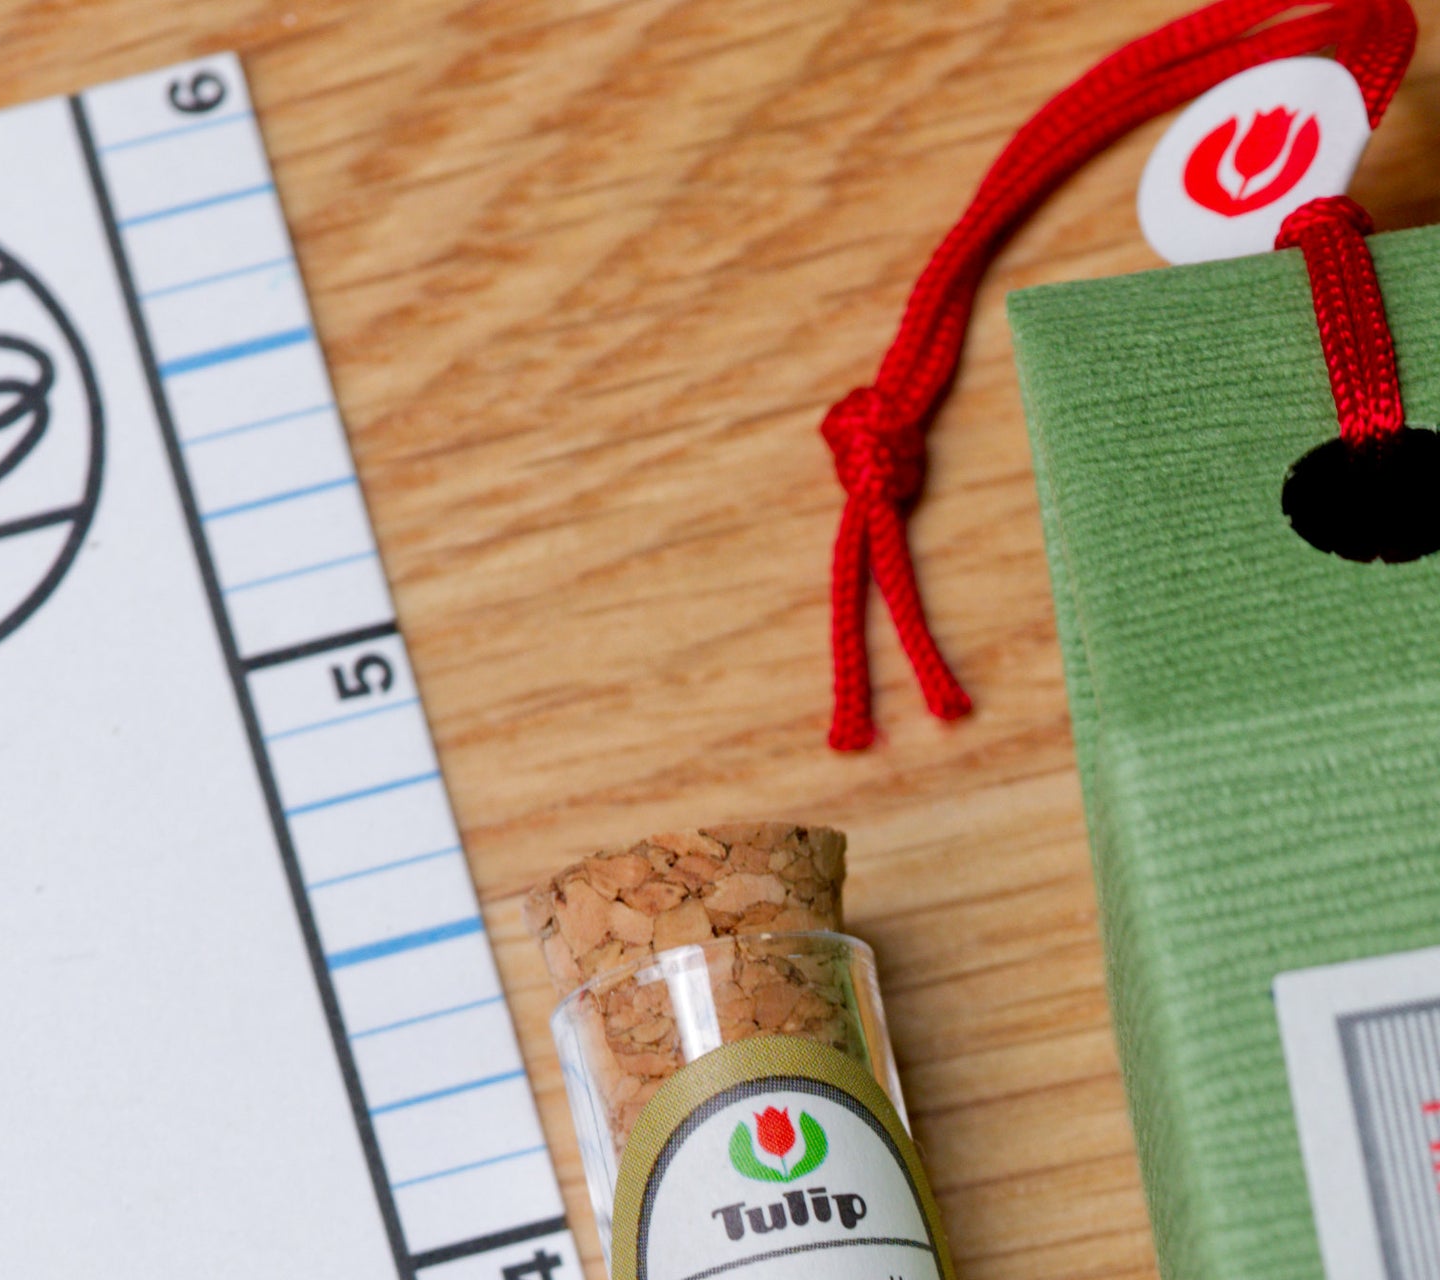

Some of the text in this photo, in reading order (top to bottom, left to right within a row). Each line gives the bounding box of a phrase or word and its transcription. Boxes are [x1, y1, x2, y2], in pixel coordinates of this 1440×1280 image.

[167, 70, 227, 115] 6
[331, 650, 396, 700] 5
[712, 1186, 868, 1242] Tulip
